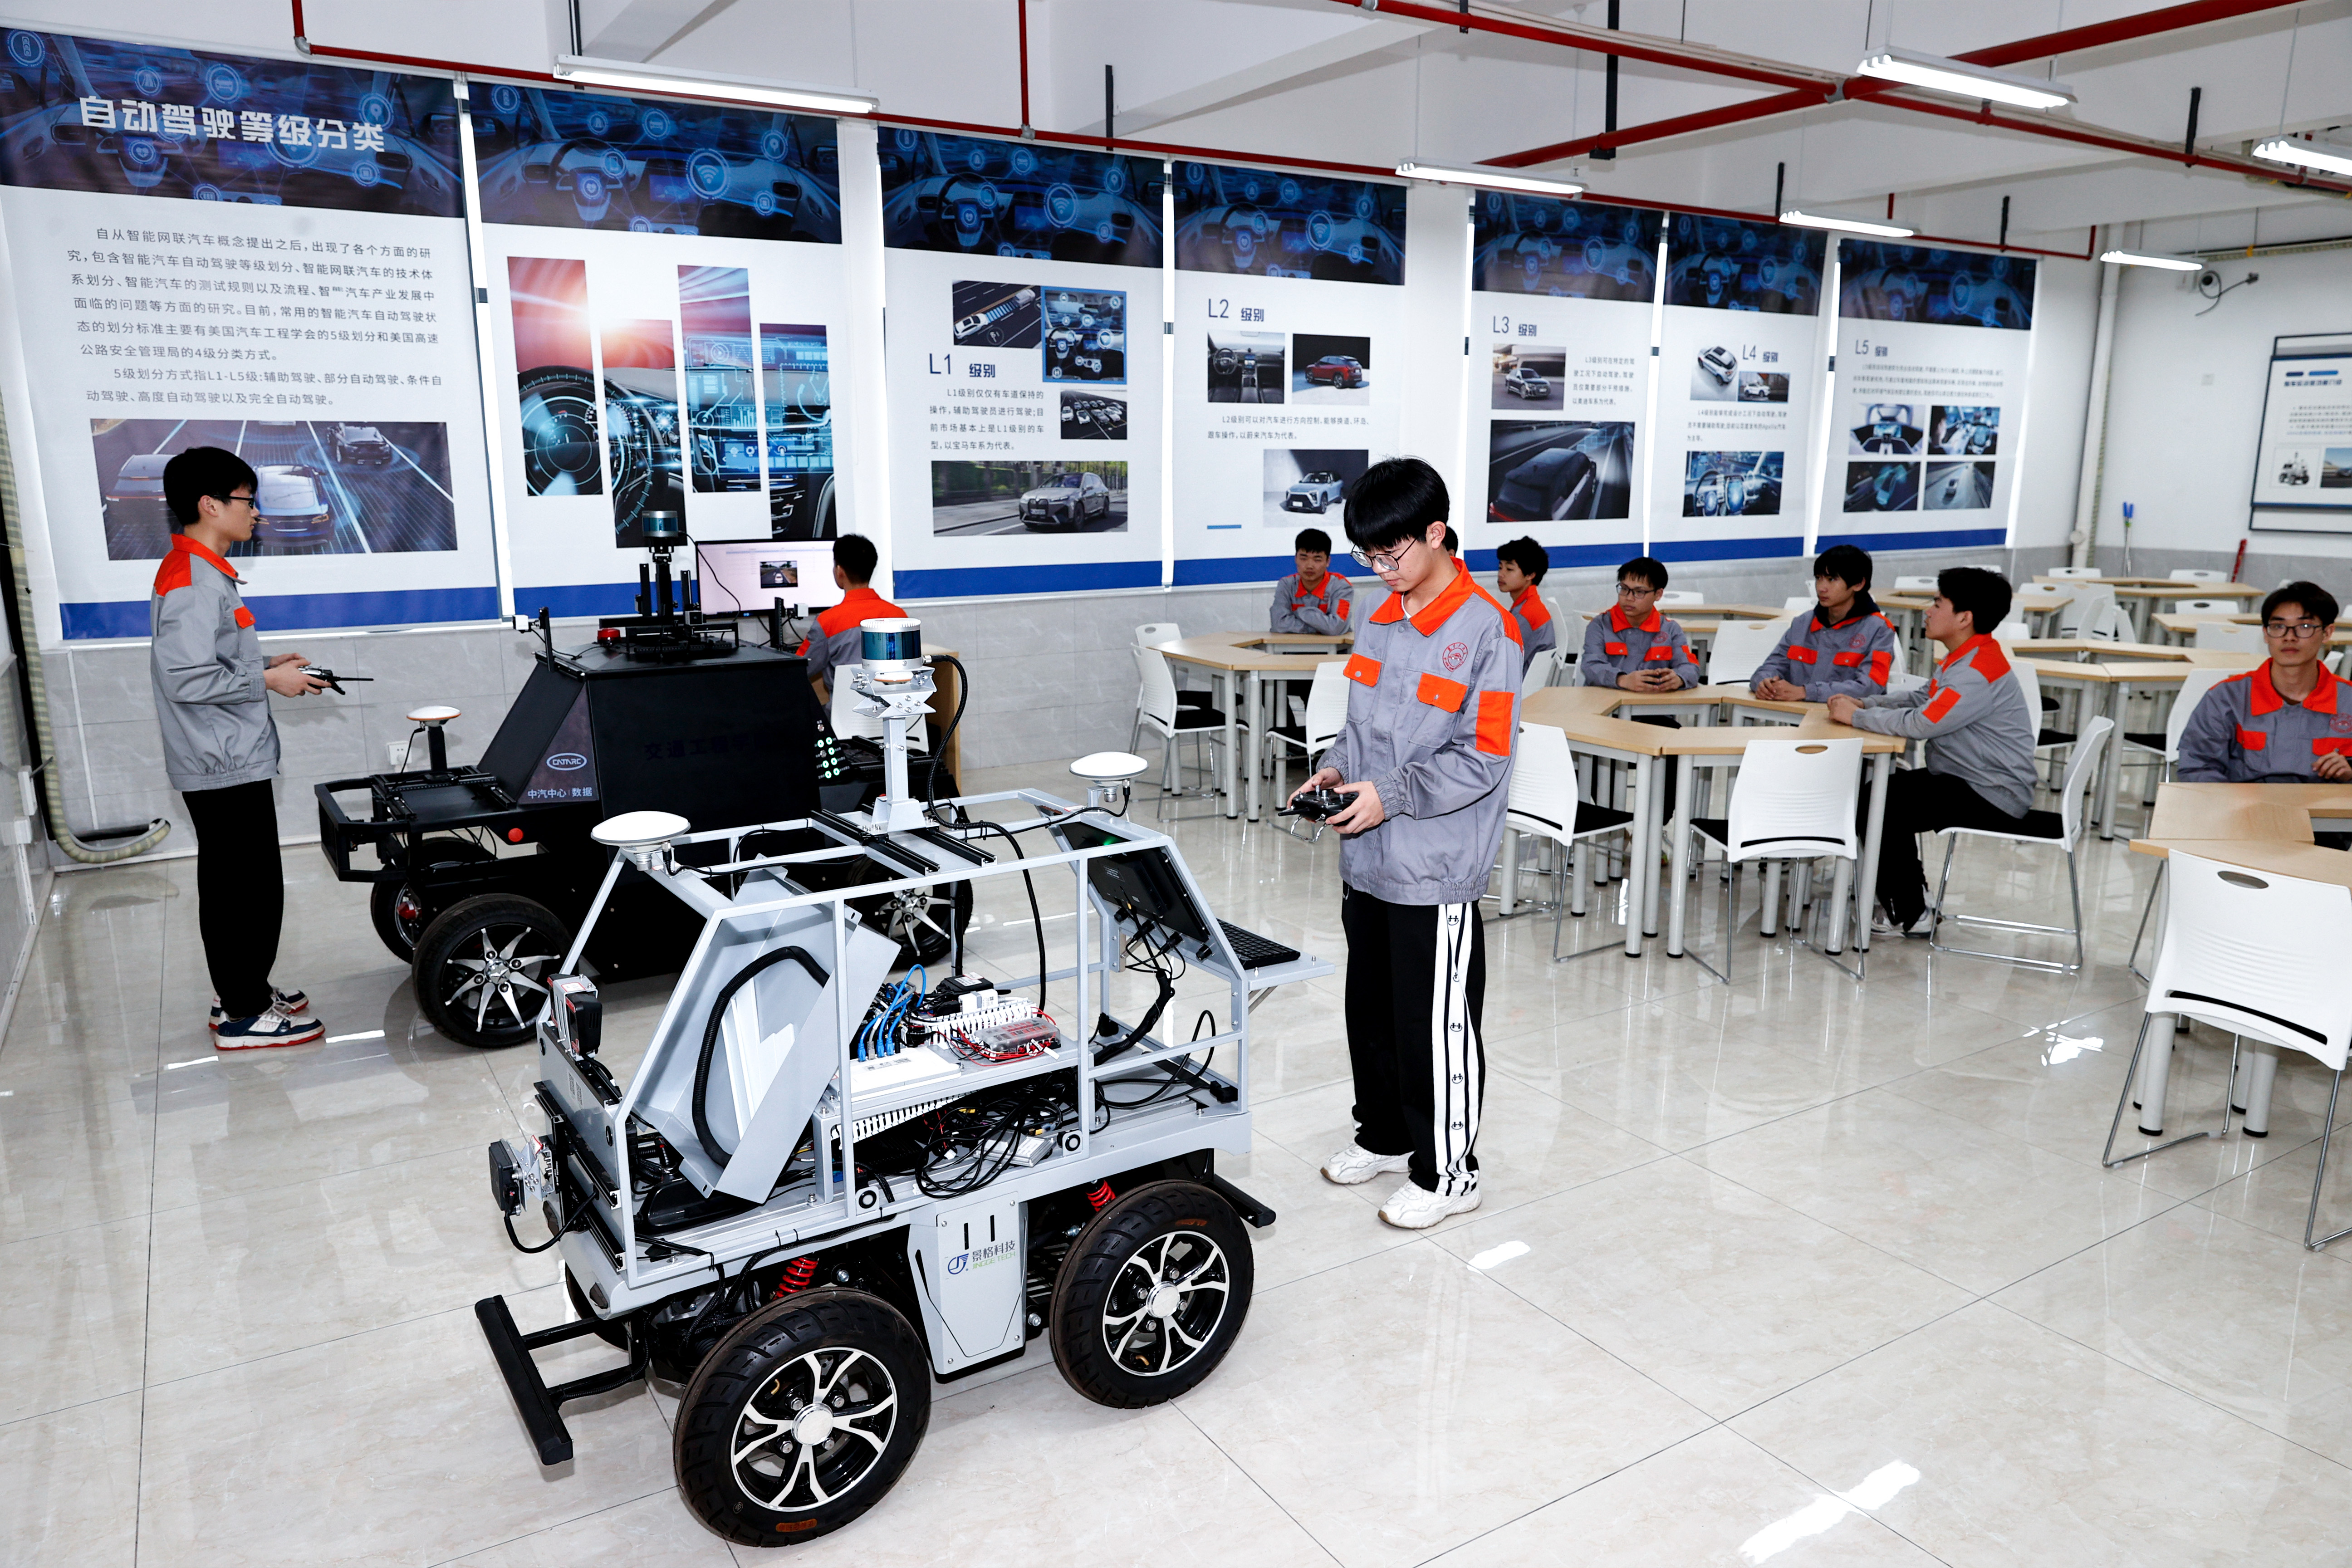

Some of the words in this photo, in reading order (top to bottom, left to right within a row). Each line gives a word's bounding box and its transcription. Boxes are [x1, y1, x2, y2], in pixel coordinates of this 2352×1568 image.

[79, 95, 385, 152] 自动驾驶等级分类
[97, 228, 431, 259] 自从智能网联汽车概念提出之后，出现了各个方面的研
[67, 250, 433, 280] 究，包含智能汽车自动驾驶等级划分、智能网联汽车的技术体
[74, 298, 437, 323] 面临的问题等方面的研究。目前，常用的智能汽车自动驾驶状
[1208, 298, 1229, 318] L2
[1240, 308, 1264, 322] 级别
[77, 320, 438, 343] 态的划分标准主要有美国汽车工程学会的5级划分和美国高速
[1493, 315, 1509, 334] L3
[1518, 323, 1537, 337] 级别
[80, 344, 276, 360] 公路安全管理局的4级分类方式。
[1742, 344, 1757, 360] L4
[1855, 339, 1869, 355] L5
[929, 353, 951, 375] L1
[969, 363, 996, 378] 级别
[86, 390, 333, 405] 动驾驶、高度自动驾驶以及完全自动驾驶。
[947, 388, 1044, 399] L1级别仅仅有车道保持的
[929, 405, 1043, 417] 操作，辅助驾驶员进行驾驶；目
[930, 423, 1044, 433] 前市场基本上是L1级别的车
[931, 441, 1014, 450] 型，以宝马车系为代表。
[528, 788, 567, 799] 中汽中心
[572, 787, 593, 797] 数据
[972, 1240, 1016, 1262] 景格科技
[972, 1258, 995, 1269] JINGGE
[997, 1251, 1016, 1261] TECH
